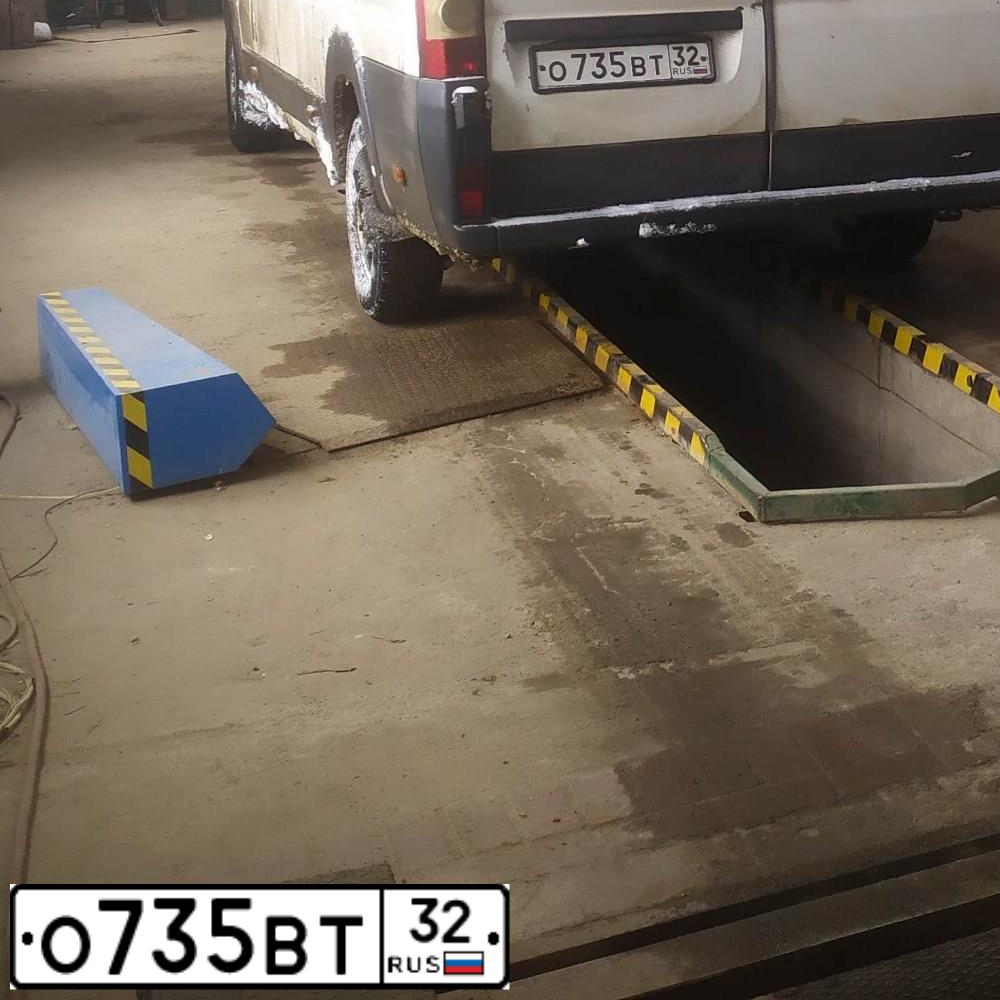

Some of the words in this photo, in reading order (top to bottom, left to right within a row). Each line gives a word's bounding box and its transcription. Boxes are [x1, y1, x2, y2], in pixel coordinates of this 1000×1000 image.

[549, 51, 663, 82] О735ВТ
[672, 45, 700, 67] 32
[672, 66, 692, 76] RUS
